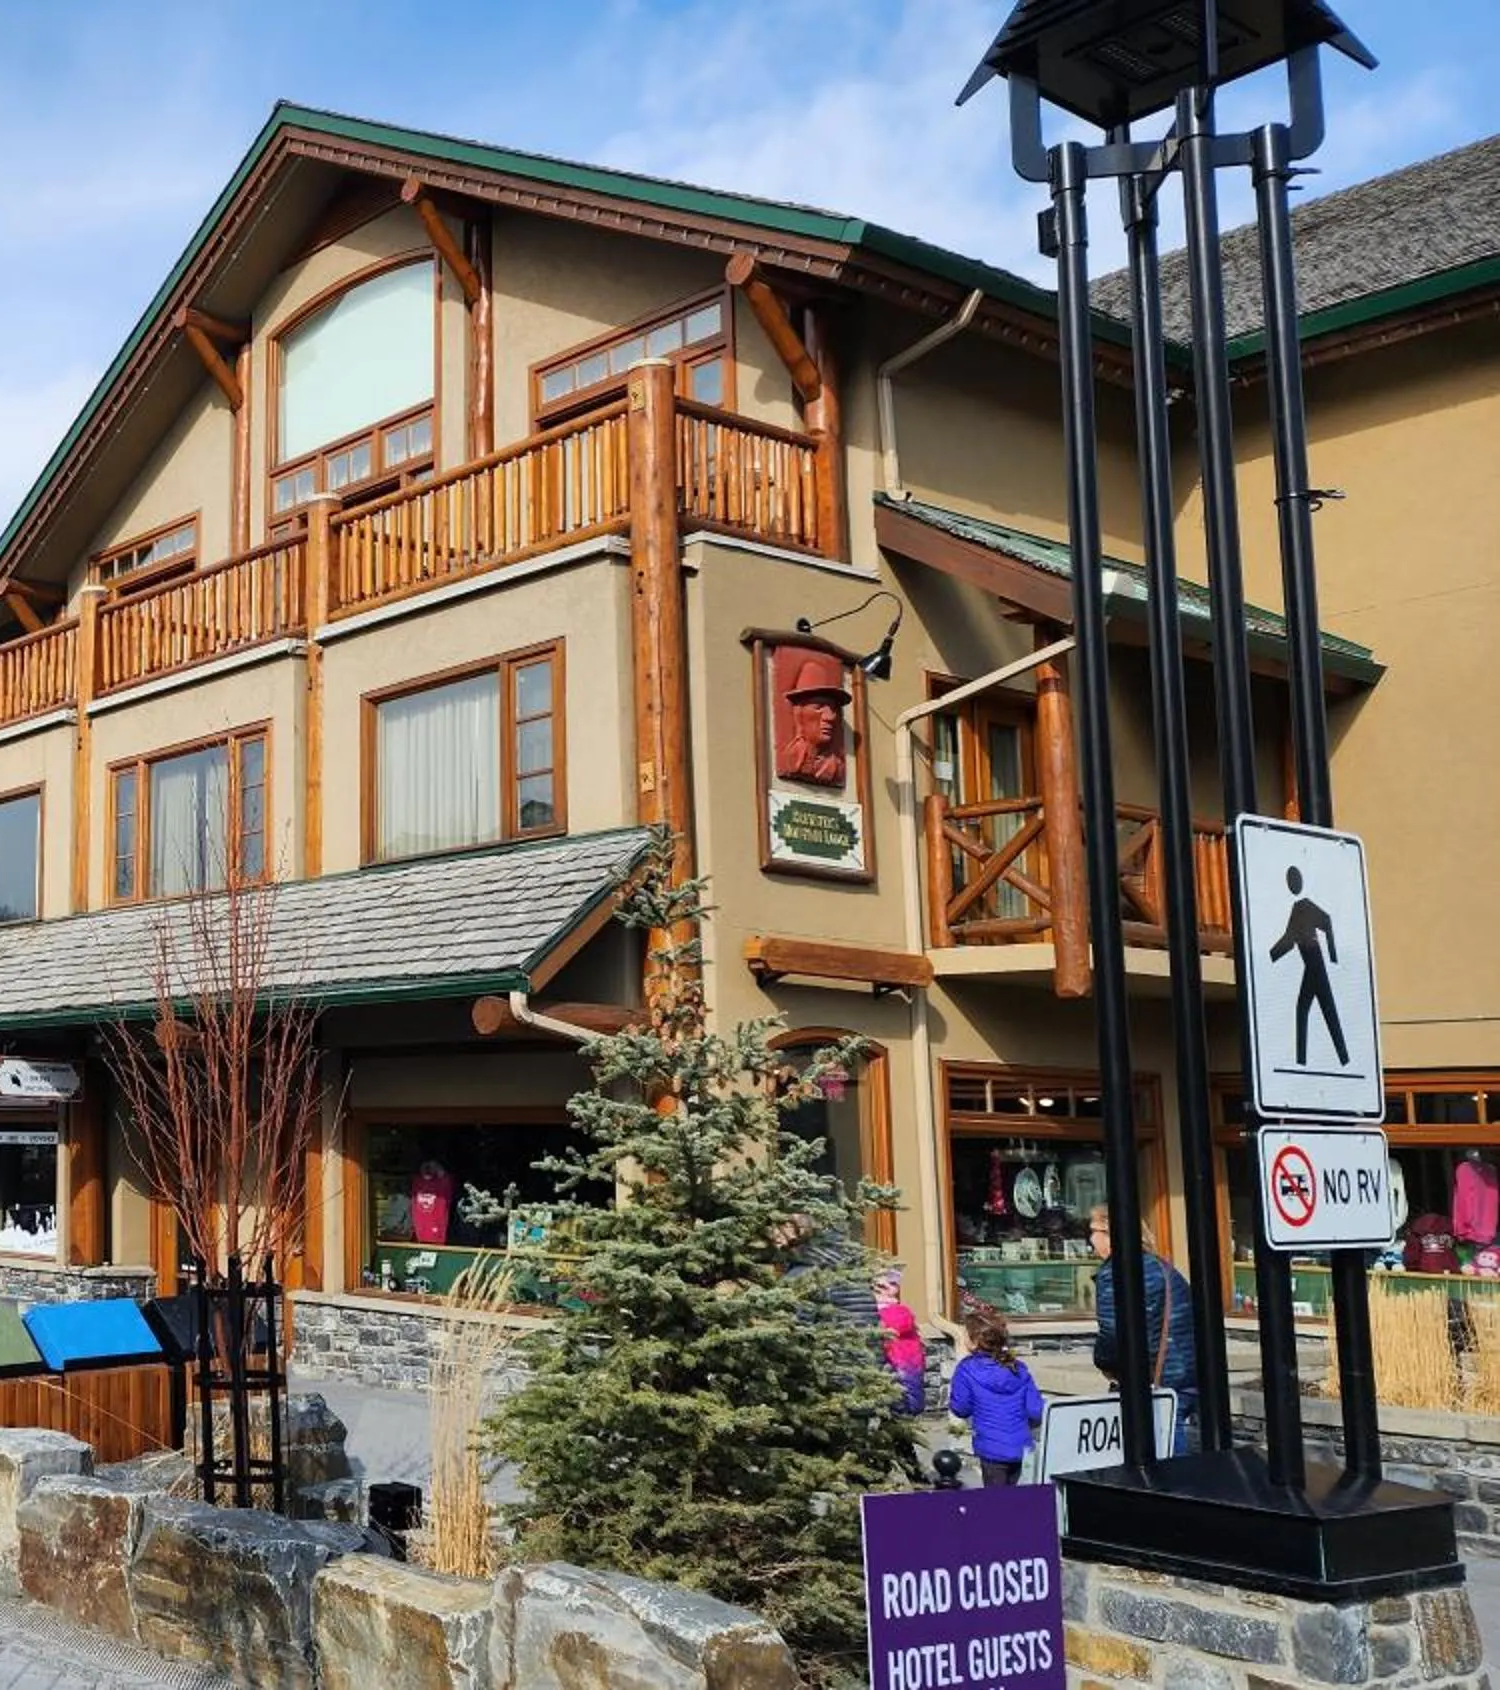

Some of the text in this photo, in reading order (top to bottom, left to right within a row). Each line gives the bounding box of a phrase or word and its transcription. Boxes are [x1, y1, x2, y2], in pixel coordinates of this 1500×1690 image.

[1323, 1168, 1381, 1204] NO RV
[1077, 1415, 1121, 1455] ROA
[882, 1557, 1050, 1620] ROAD CLOSED
[888, 1629, 1053, 1690] HOTEL GUESTS
